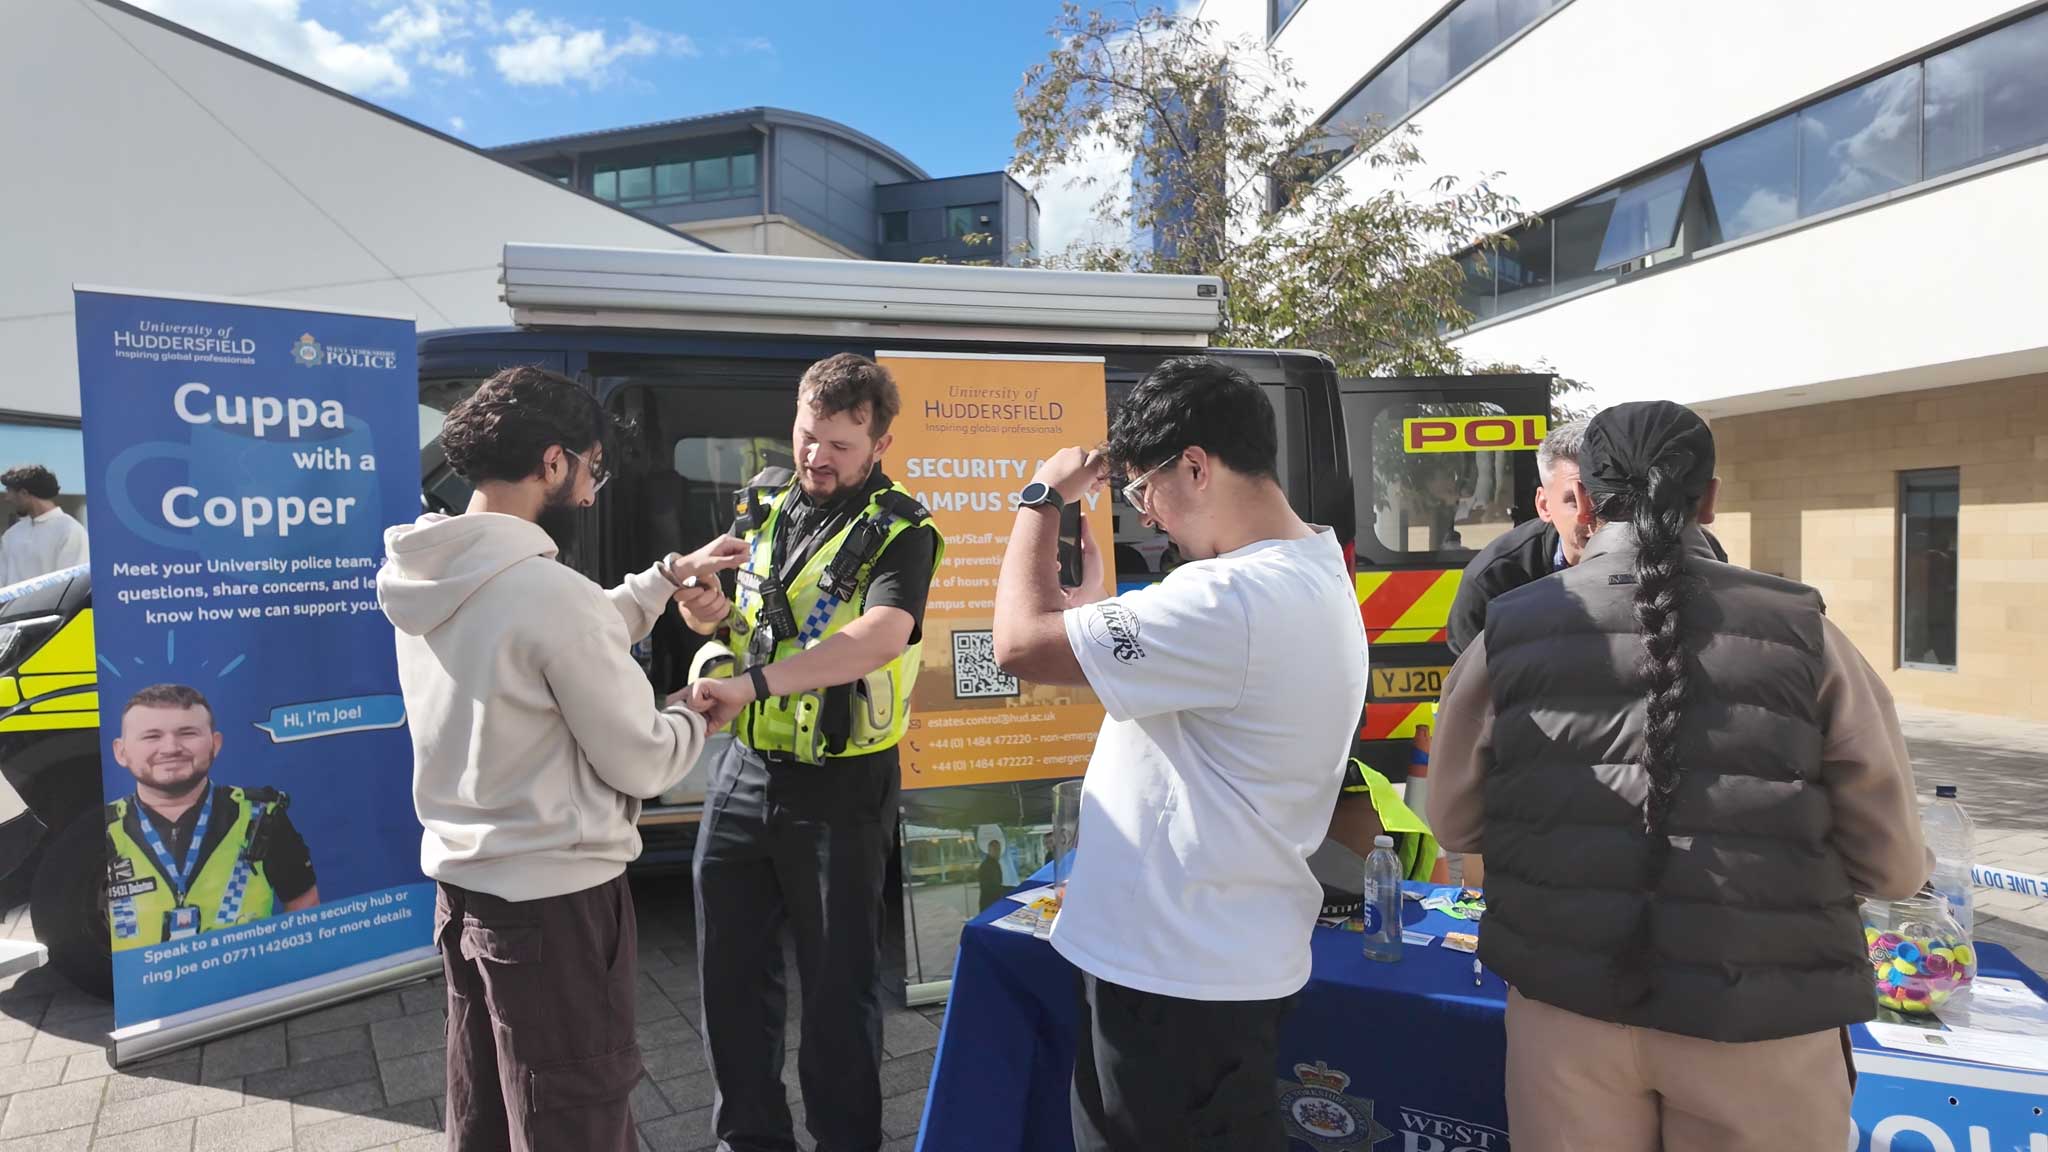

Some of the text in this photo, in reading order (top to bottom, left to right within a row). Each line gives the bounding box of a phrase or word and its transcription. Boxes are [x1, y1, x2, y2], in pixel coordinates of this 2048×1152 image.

[139, 320, 233, 339] University of
[114, 330, 256, 355] HUDDERSFIELD
[115, 349, 256, 365] Inspiring global professionals
[326, 352, 397, 369] POLICE
[948, 385, 1040, 402] University of
[173, 381, 345, 437] Cuppa
[925, 399, 1063, 421] HUDDERSFIELD
[926, 422, 1063, 435] Inspiring global professionals
[1410, 419, 1543, 449] POL
[292, 447, 376, 471] with a
[906, 457, 1028, 478] SECURITY
[161, 486, 356, 537] Copper
[914, 491, 1001, 512] AMPUS
[113, 562, 159, 577] Meet
[162, 562, 202, 578] your
[207, 557, 287, 573] University
[291, 556, 332, 573] police
[335, 557, 377, 568] team,
[954, 555, 1002, 568] preventi
[118, 577, 377, 604] questions, share concerns, and le
[943, 576, 956, 587] of
[956, 576, 989, 587] hours
[146, 610, 193, 624] know
[198, 606, 234, 621] how
[238, 606, 261, 618] we
[264, 605, 290, 616] can
[293, 600, 347, 616] support
[926, 600, 995, 611] ampus even
[1382, 671, 1441, 692] YJ20
[283, 712, 304, 728] Hi,
[307, 709, 330, 725] I'm
[928, 738, 948, 749] +44
[950, 737, 964, 749] (0)
[966, 735, 992, 747] 1484
[993, 733, 1031, 745] 472220
[1040, 731, 1098, 743] non-emerge
[931, 761, 951, 772] +44
[952, 759, 967, 771] (0)
[995, 755, 1033, 767] 472222
[1042, 754, 1091, 765] emergenc
[1984, 870, 2004, 889] DO
[2006, 874, 2038, 896] LINE
[144, 891, 408, 964] Speak to a member of the security hub or
[142, 908, 413, 985] ring Joe on 07711426033 for more details
[1400, 1111, 1496, 1149] WEST
